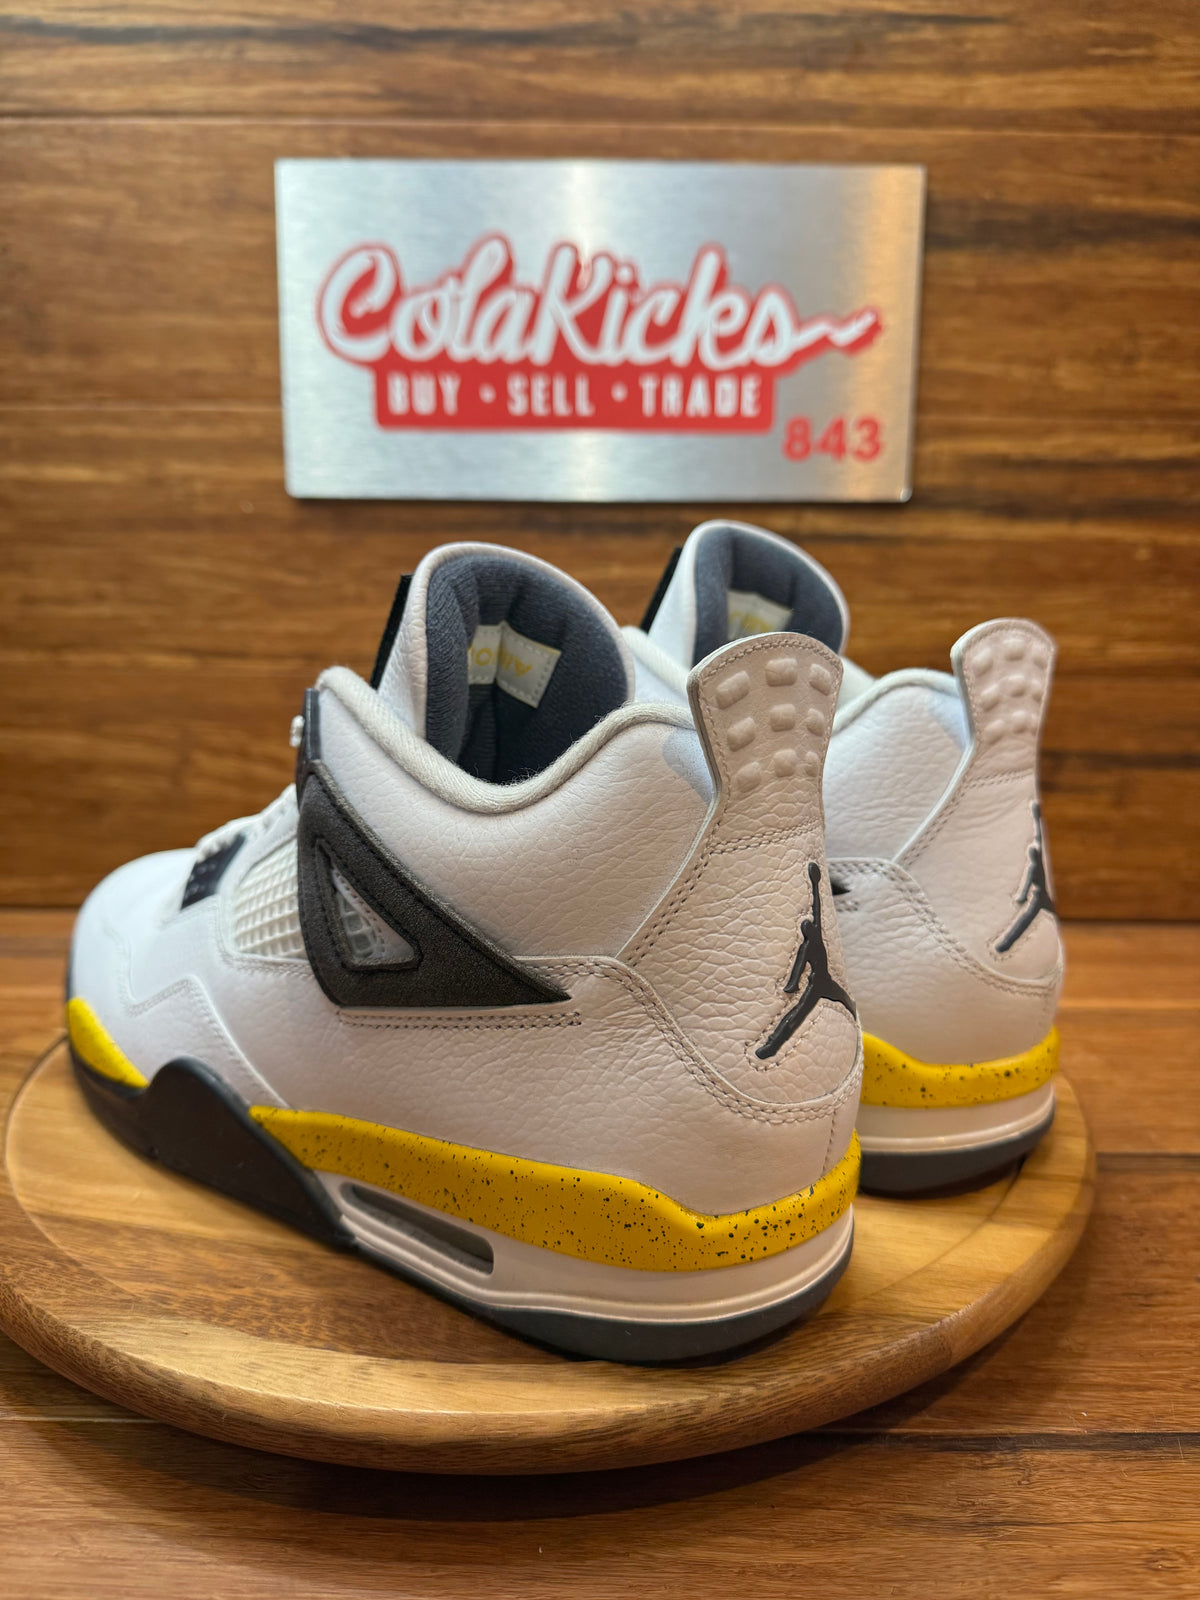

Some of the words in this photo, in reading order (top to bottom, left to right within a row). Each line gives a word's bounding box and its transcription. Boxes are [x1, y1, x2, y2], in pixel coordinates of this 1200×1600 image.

[387, 371, 461, 416] BUY
[507, 372, 596, 417] SELL
[638, 373, 762, 418] TRADE
[782, 415, 884, 463] 843
